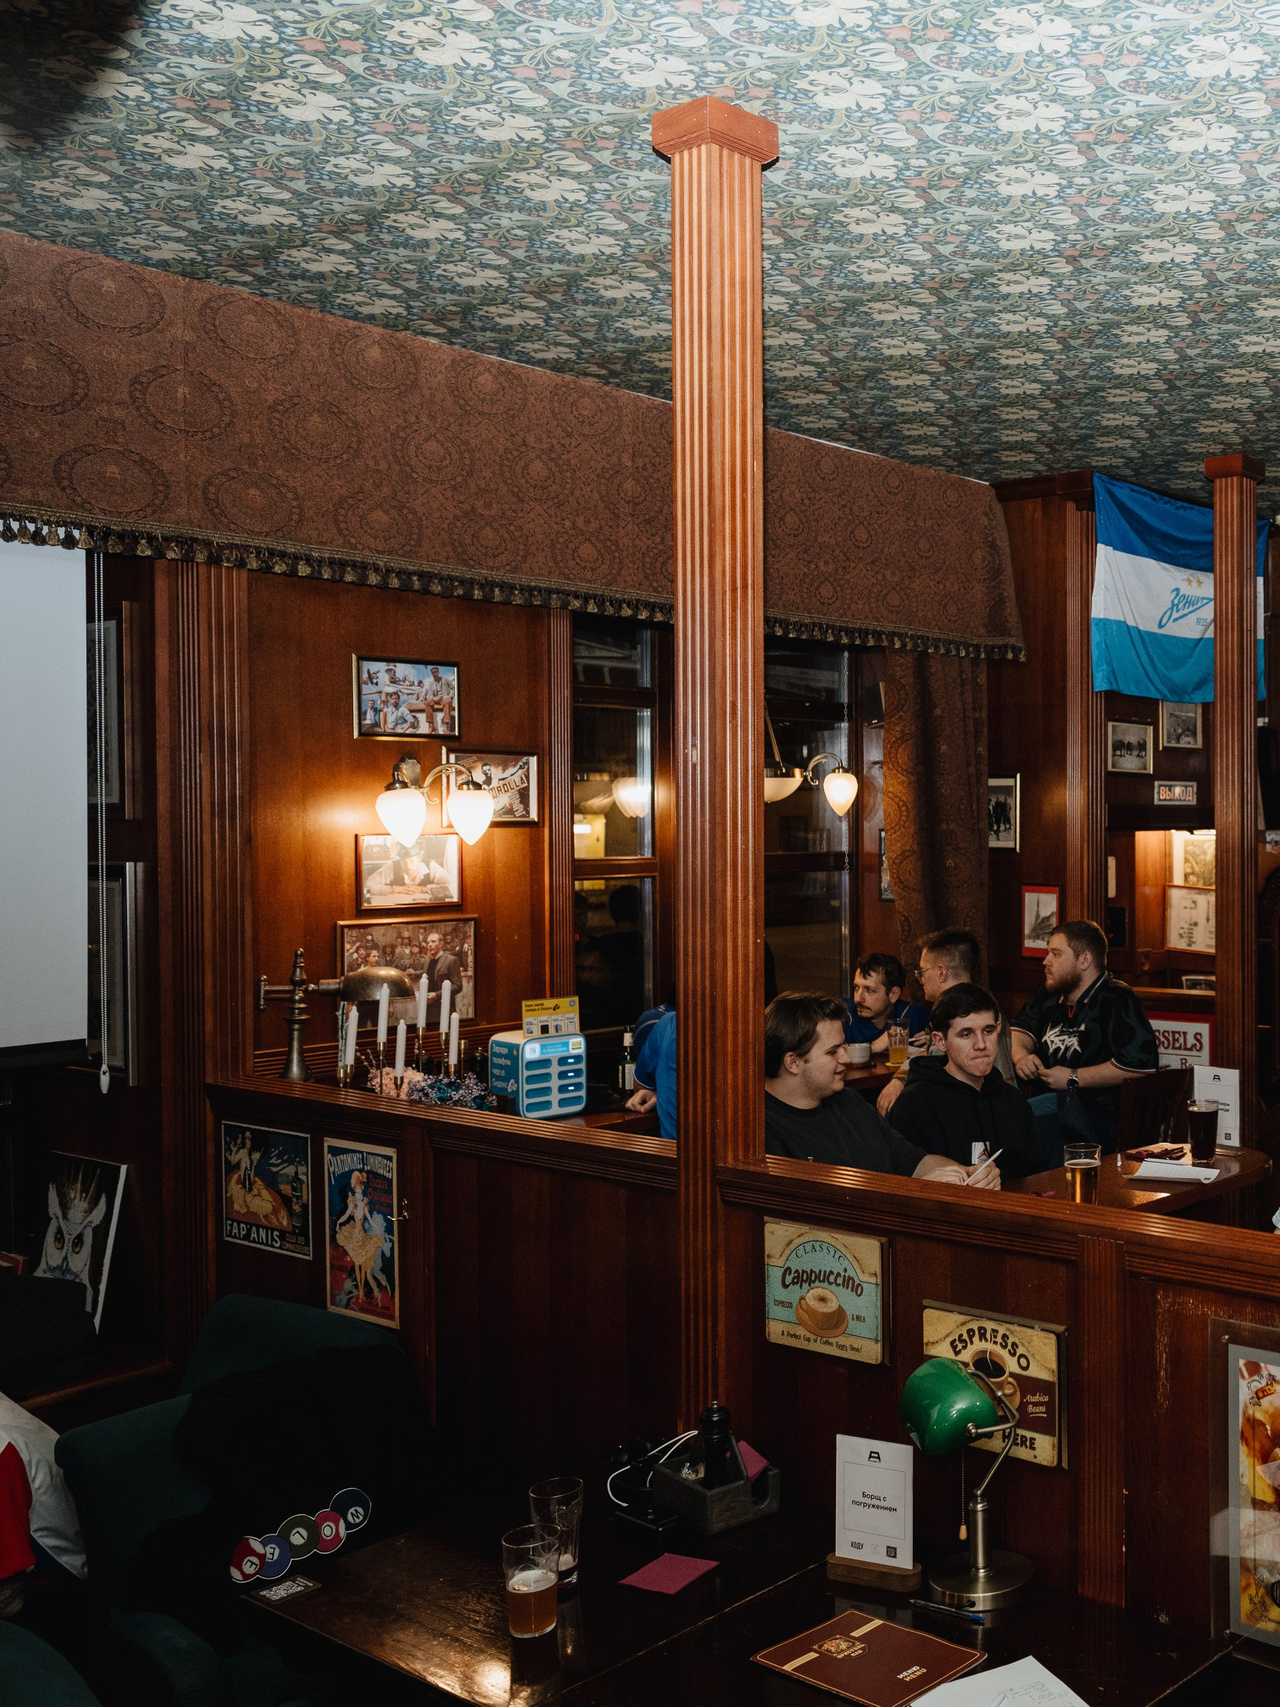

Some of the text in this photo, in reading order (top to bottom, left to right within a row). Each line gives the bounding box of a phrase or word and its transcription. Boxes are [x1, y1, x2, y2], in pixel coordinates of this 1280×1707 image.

[1160, 787, 1193, 801] ВЫХОД
[226, 1220, 281, 1247] FAP'ANIS
[795, 1243, 846, 1266] CLASSIC
[781, 1266, 864, 1297] Cappuccino
[773, 1298, 793, 1309] ESPRESSO
[855, 1314, 866, 1323] MILK
[787, 1330, 801, 1339] Perfect
[803, 1334, 811, 1343] Cup
[820, 1338, 834, 1347] Coffee
[950, 1326, 1031, 1372] ESPRESSO
[1023, 1393, 1049, 1403] Arabica
[1026, 1404, 1047, 1414] Beans
[1002, 1431, 1037, 1451] HERE
[862, 1491, 881, 1502] Борщ
[851, 1499, 898, 1513] погружением
[896, 1665, 920, 1680] МЕНЮ
[903, 1667, 927, 1682] MENU
